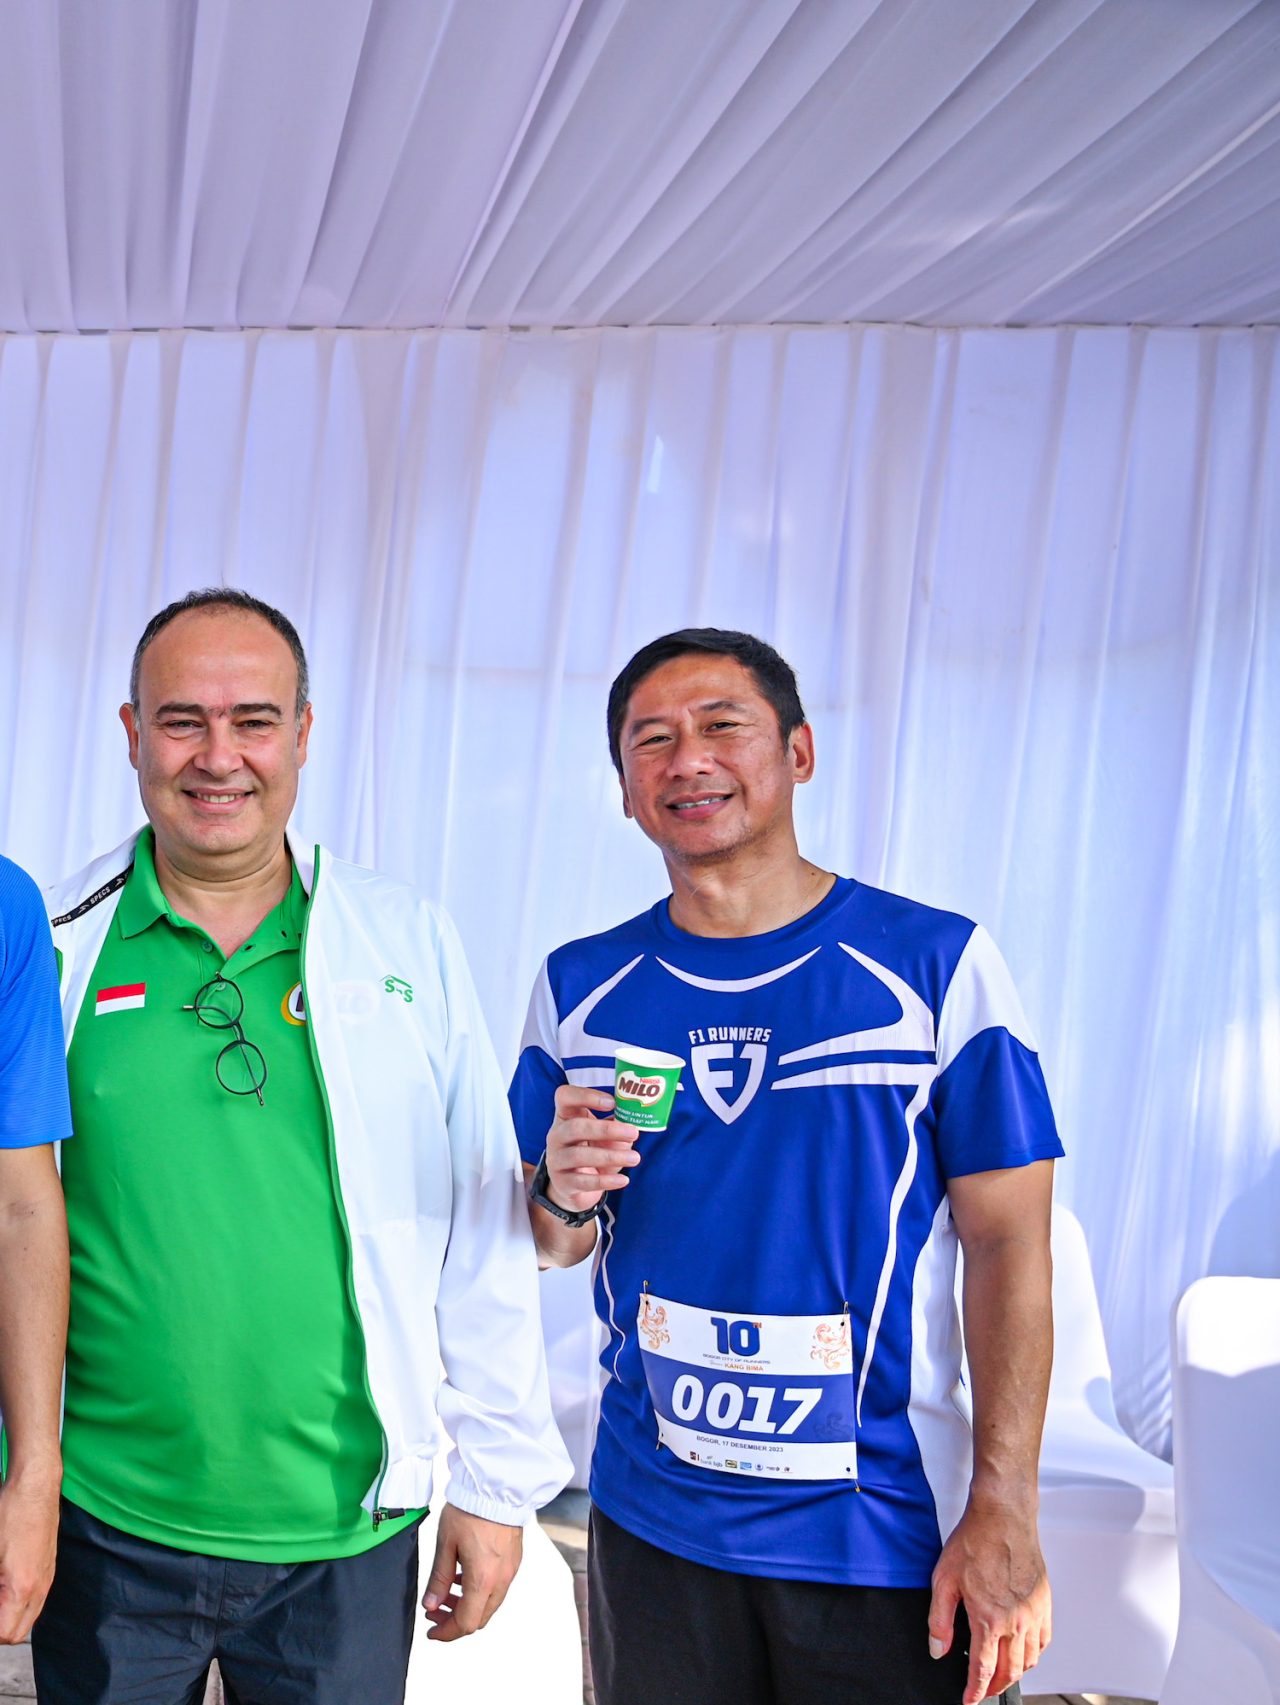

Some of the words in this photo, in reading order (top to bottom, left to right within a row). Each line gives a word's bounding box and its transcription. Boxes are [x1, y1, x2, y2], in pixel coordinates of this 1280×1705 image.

[89, 886, 111, 904] SPECS
[51, 914, 72, 924] PECS
[688, 1029, 705, 1045] F1
[707, 1027, 772, 1042] RUNNERS
[618, 1077, 660, 1097] MILO
[671, 1374, 823, 1435] 0017
[730, 1441, 767, 1451] DESEMBER
